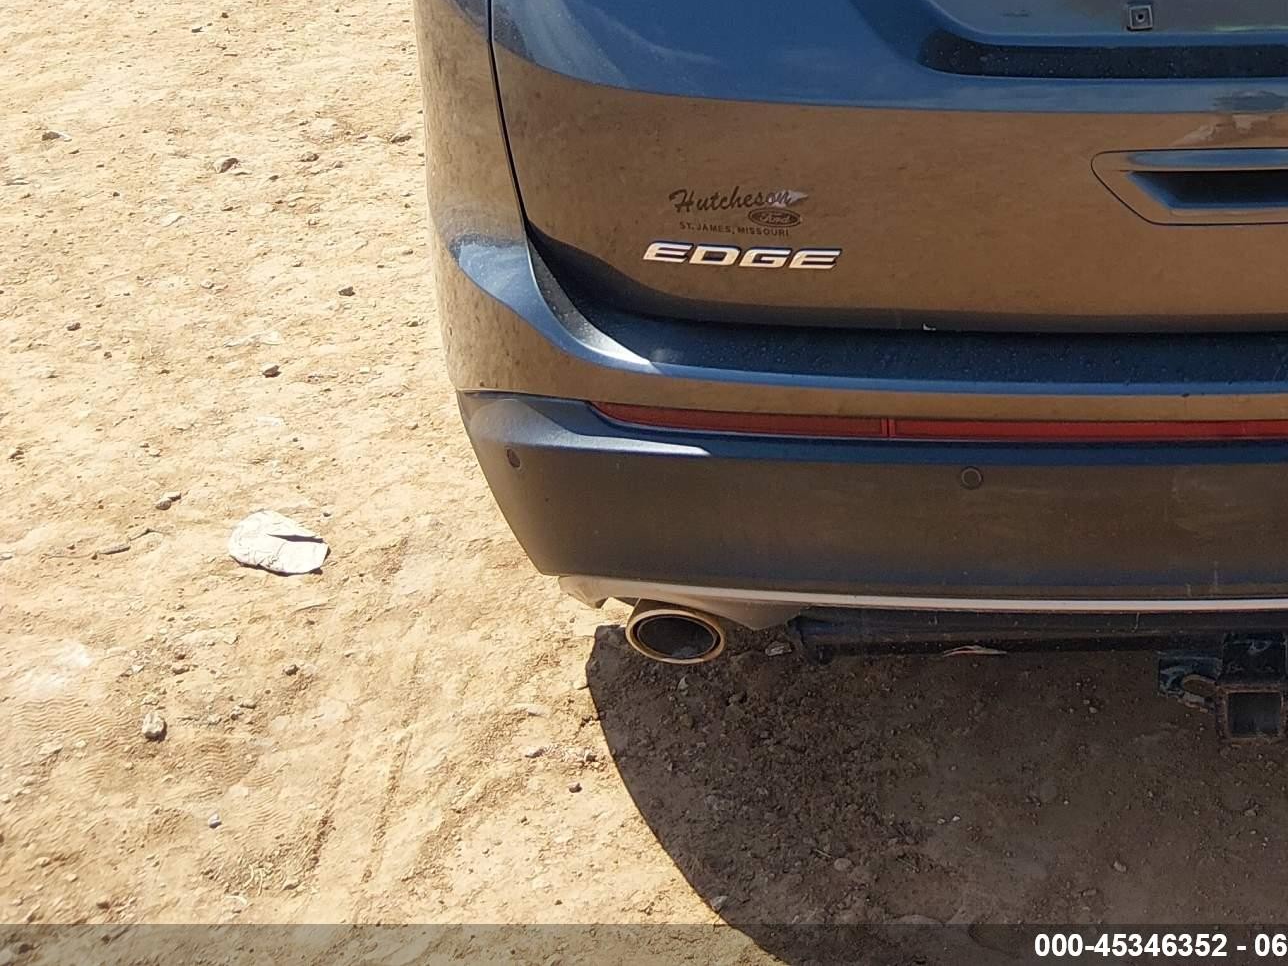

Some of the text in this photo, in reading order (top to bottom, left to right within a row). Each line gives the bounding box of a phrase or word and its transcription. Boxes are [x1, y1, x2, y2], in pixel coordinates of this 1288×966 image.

[669, 186, 792, 213] Hutcheson
[737, 226, 790, 237] MISSOURI
[642, 240, 843, 270] EDGE
